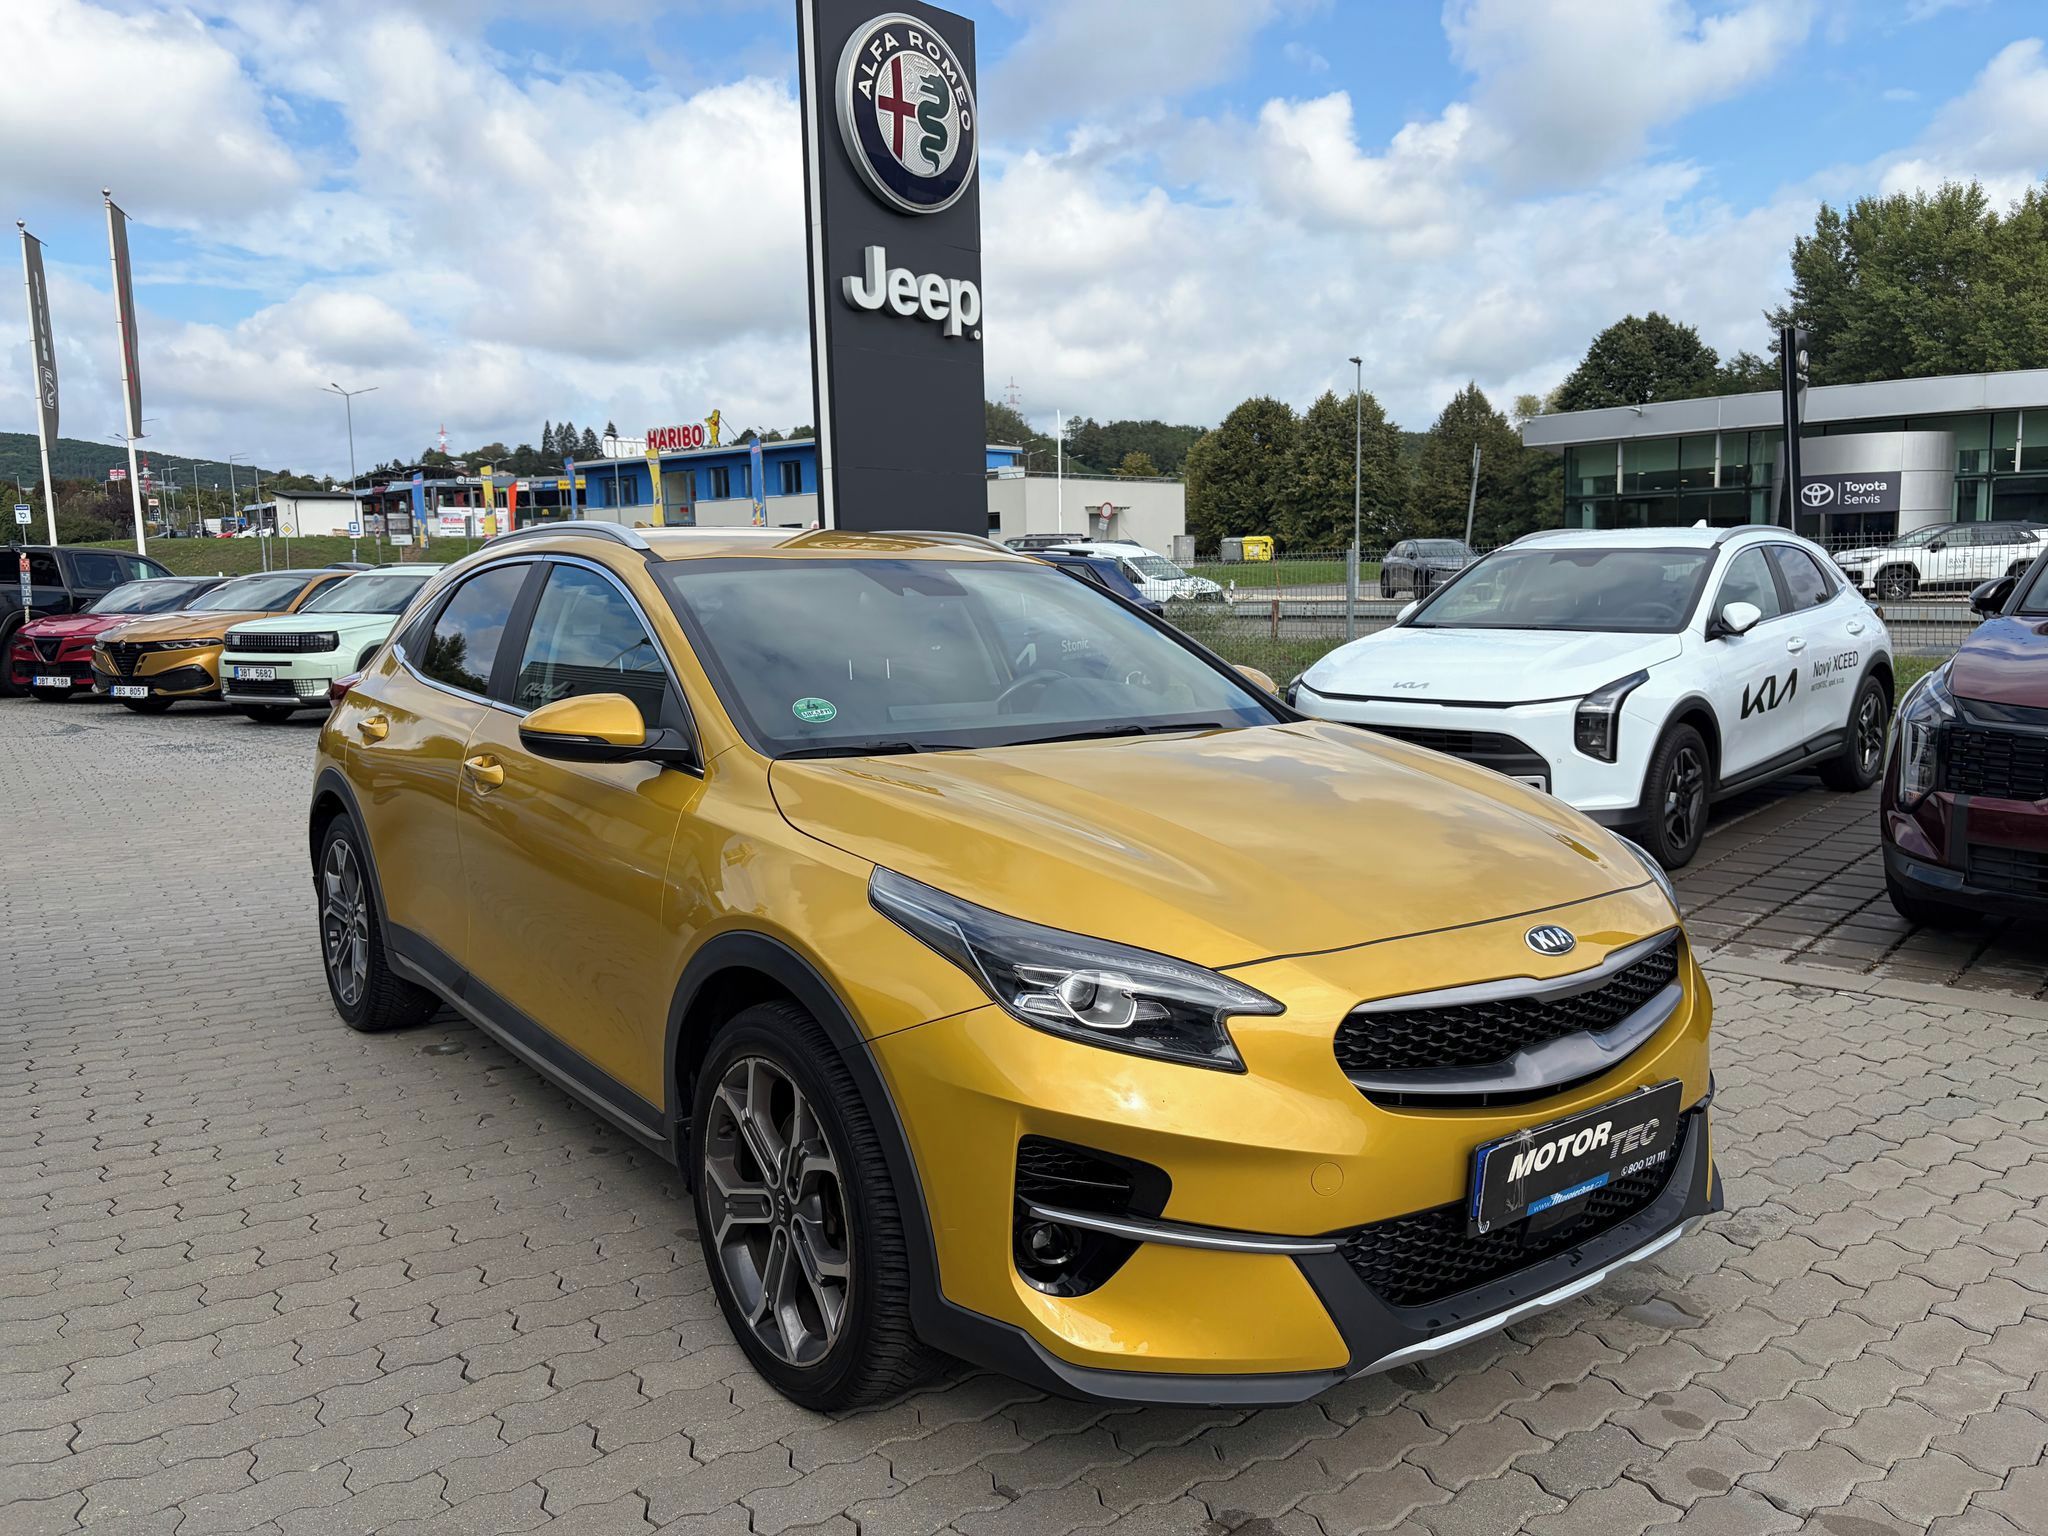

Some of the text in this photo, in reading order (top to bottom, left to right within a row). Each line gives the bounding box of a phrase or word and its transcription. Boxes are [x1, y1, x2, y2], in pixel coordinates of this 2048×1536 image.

[858, 30, 971, 131] ALFA ROMEO
[842, 245, 981, 337] Jeep
[646, 424, 703, 450] HARIBO
[1844, 481, 1888, 493] Toyota
[1844, 494, 1881, 504] Servis
[1061, 639, 1089, 652] Stonic
[240, 668, 273, 678] 3BT 5682
[1813, 651, 1859, 678] Nový XCEED
[129, 687, 145, 696] 8051
[1740, 668, 1798, 720] KIA
[1530, 926, 1573, 950] KIA
[1627, 1150, 1667, 1175] 800 121 111
[778, 1194, 786, 1223] KIA
